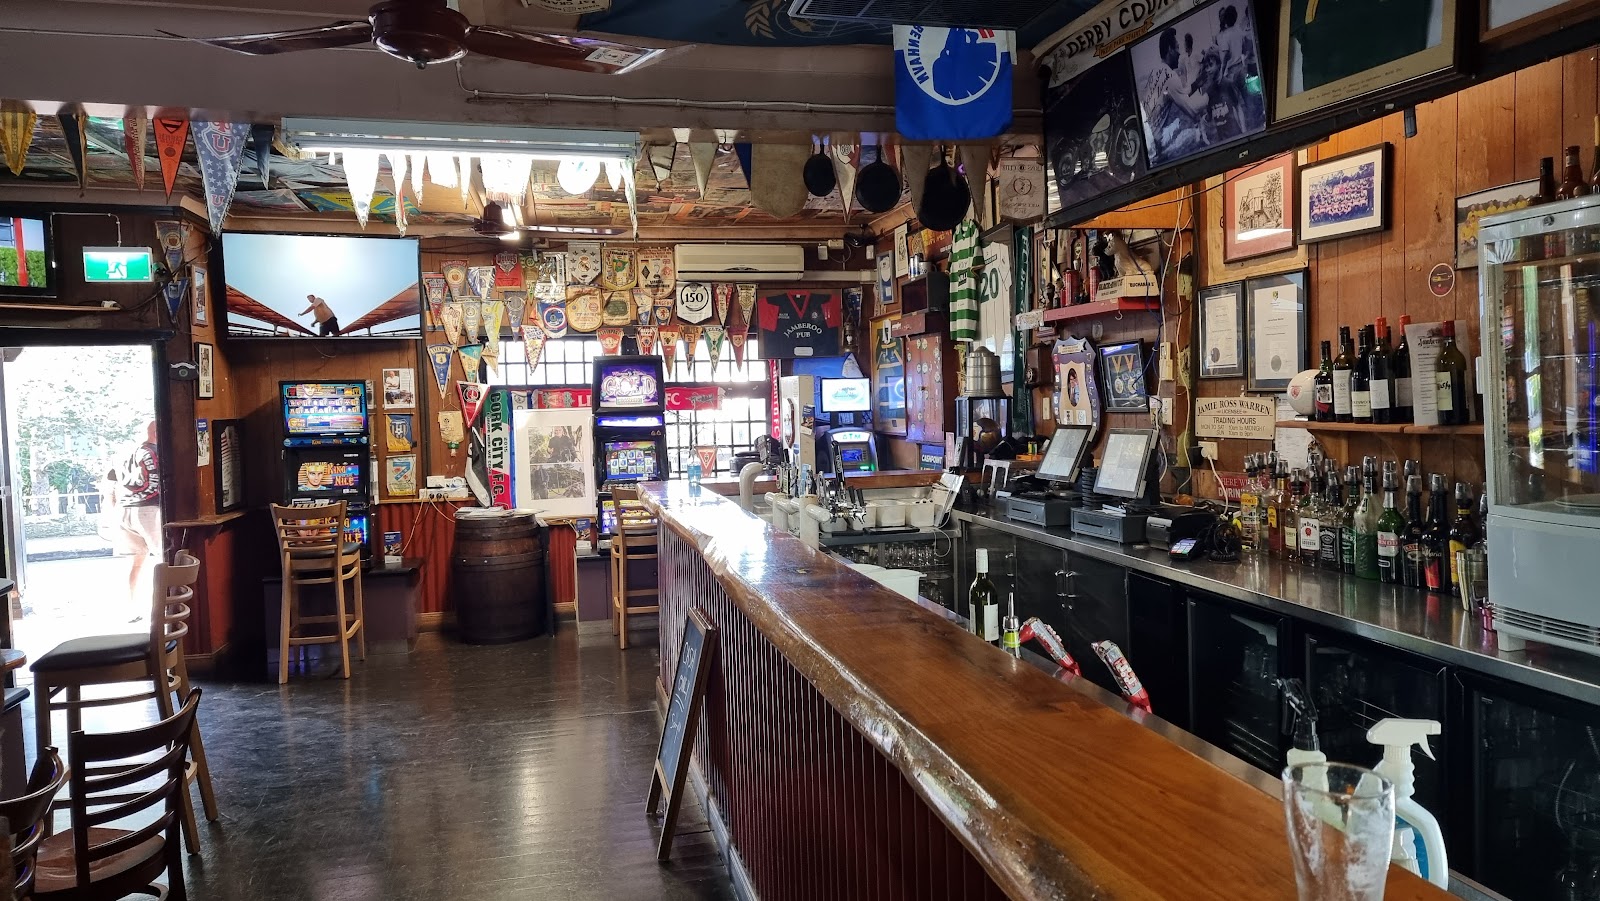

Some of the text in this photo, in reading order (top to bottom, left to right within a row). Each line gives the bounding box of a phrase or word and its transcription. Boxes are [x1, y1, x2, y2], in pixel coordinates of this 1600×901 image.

[1066, 16, 1111, 59] DERBY
[211, 134, 231, 152] U
[211, 194, 225, 206] U
[979, 267, 999, 303] 20
[685, 292, 704, 303] 150
[783, 322, 823, 338] JAMBEROO
[796, 331, 811, 339] PUB
[601, 375, 657, 397] GOLD
[490, 392, 504, 433] CORK
[1197, 399, 1271, 415] JAMIE ROSS WARREN
[1213, 416, 1257, 425] TRADING HOURS
[487, 450, 492, 460] WE
[491, 436, 504, 470] CITY
[921, 454, 943, 465] CASHPOINT
[327, 463, 347, 475] KING
[334, 475, 355, 487] NILE
[1218, 477, 1238, 487] HERE
